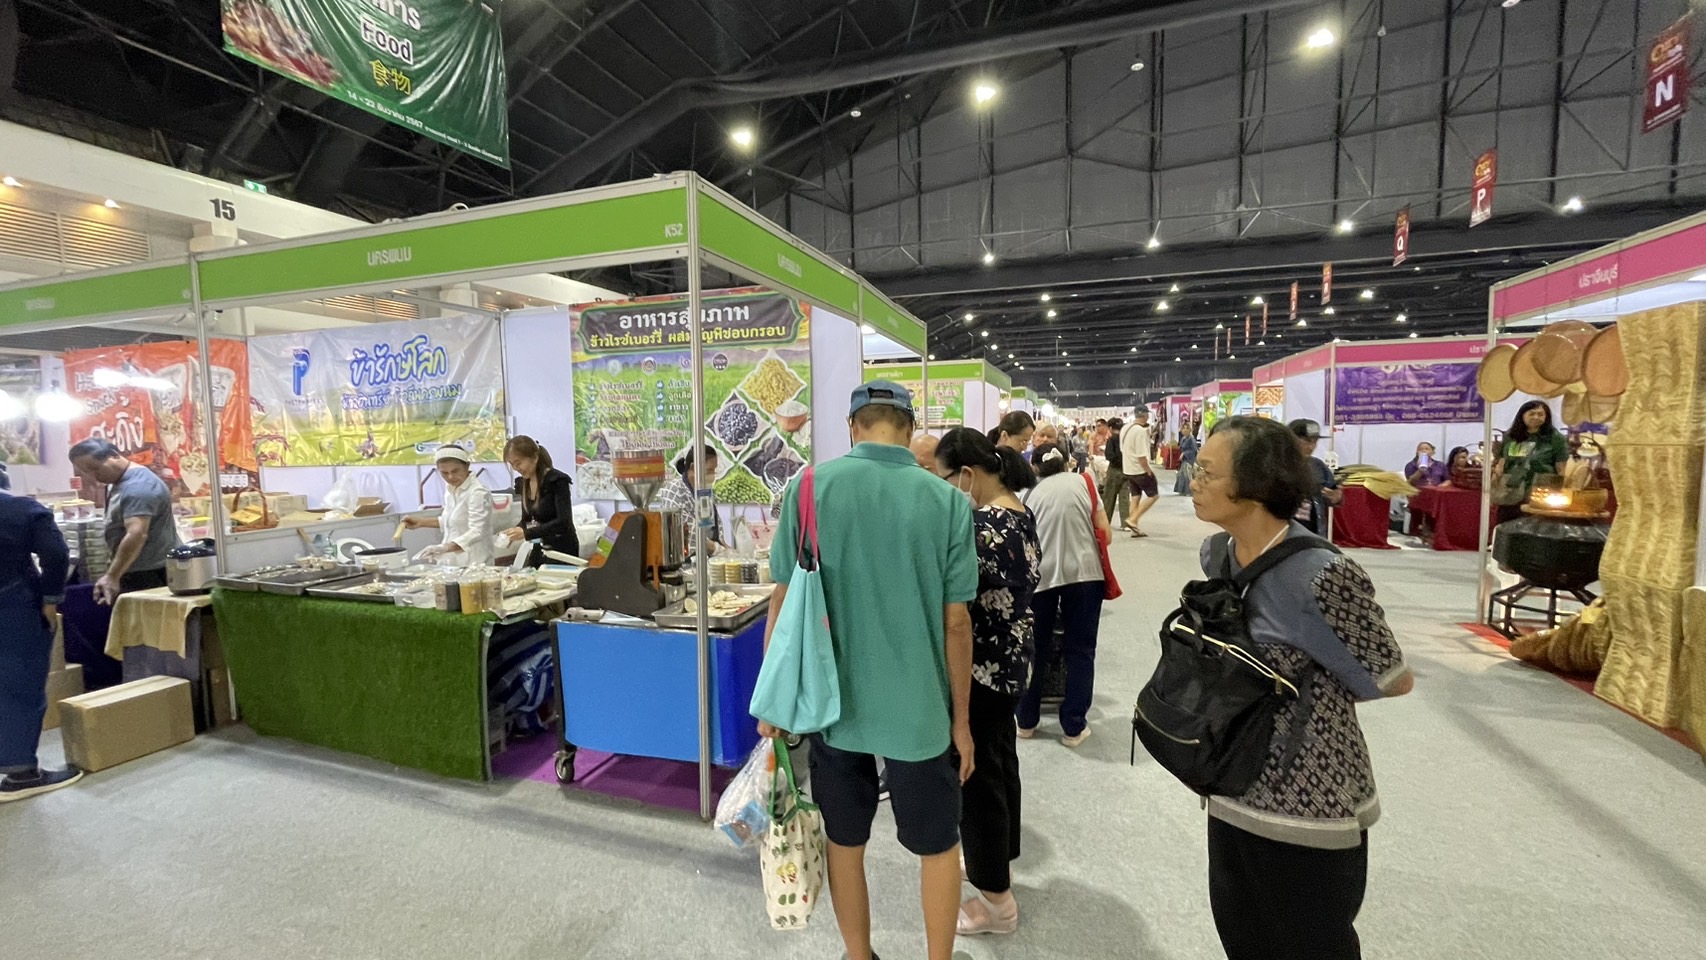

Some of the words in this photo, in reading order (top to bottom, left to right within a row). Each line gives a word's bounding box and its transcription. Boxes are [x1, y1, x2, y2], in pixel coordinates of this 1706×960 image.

[361, 16, 414, 65] Food
[369, 59, 411, 95] 食物
[347, 90, 358, 102] 14
[1655, 74, 1674, 107] N
[209, 198, 236, 221] 15
[1477, 188, 1487, 209] P
[665, 223, 683, 239] K52
[367, 247, 412, 267] นครพนม
[1578, 262, 1618, 289] ปราจีนบุรี
